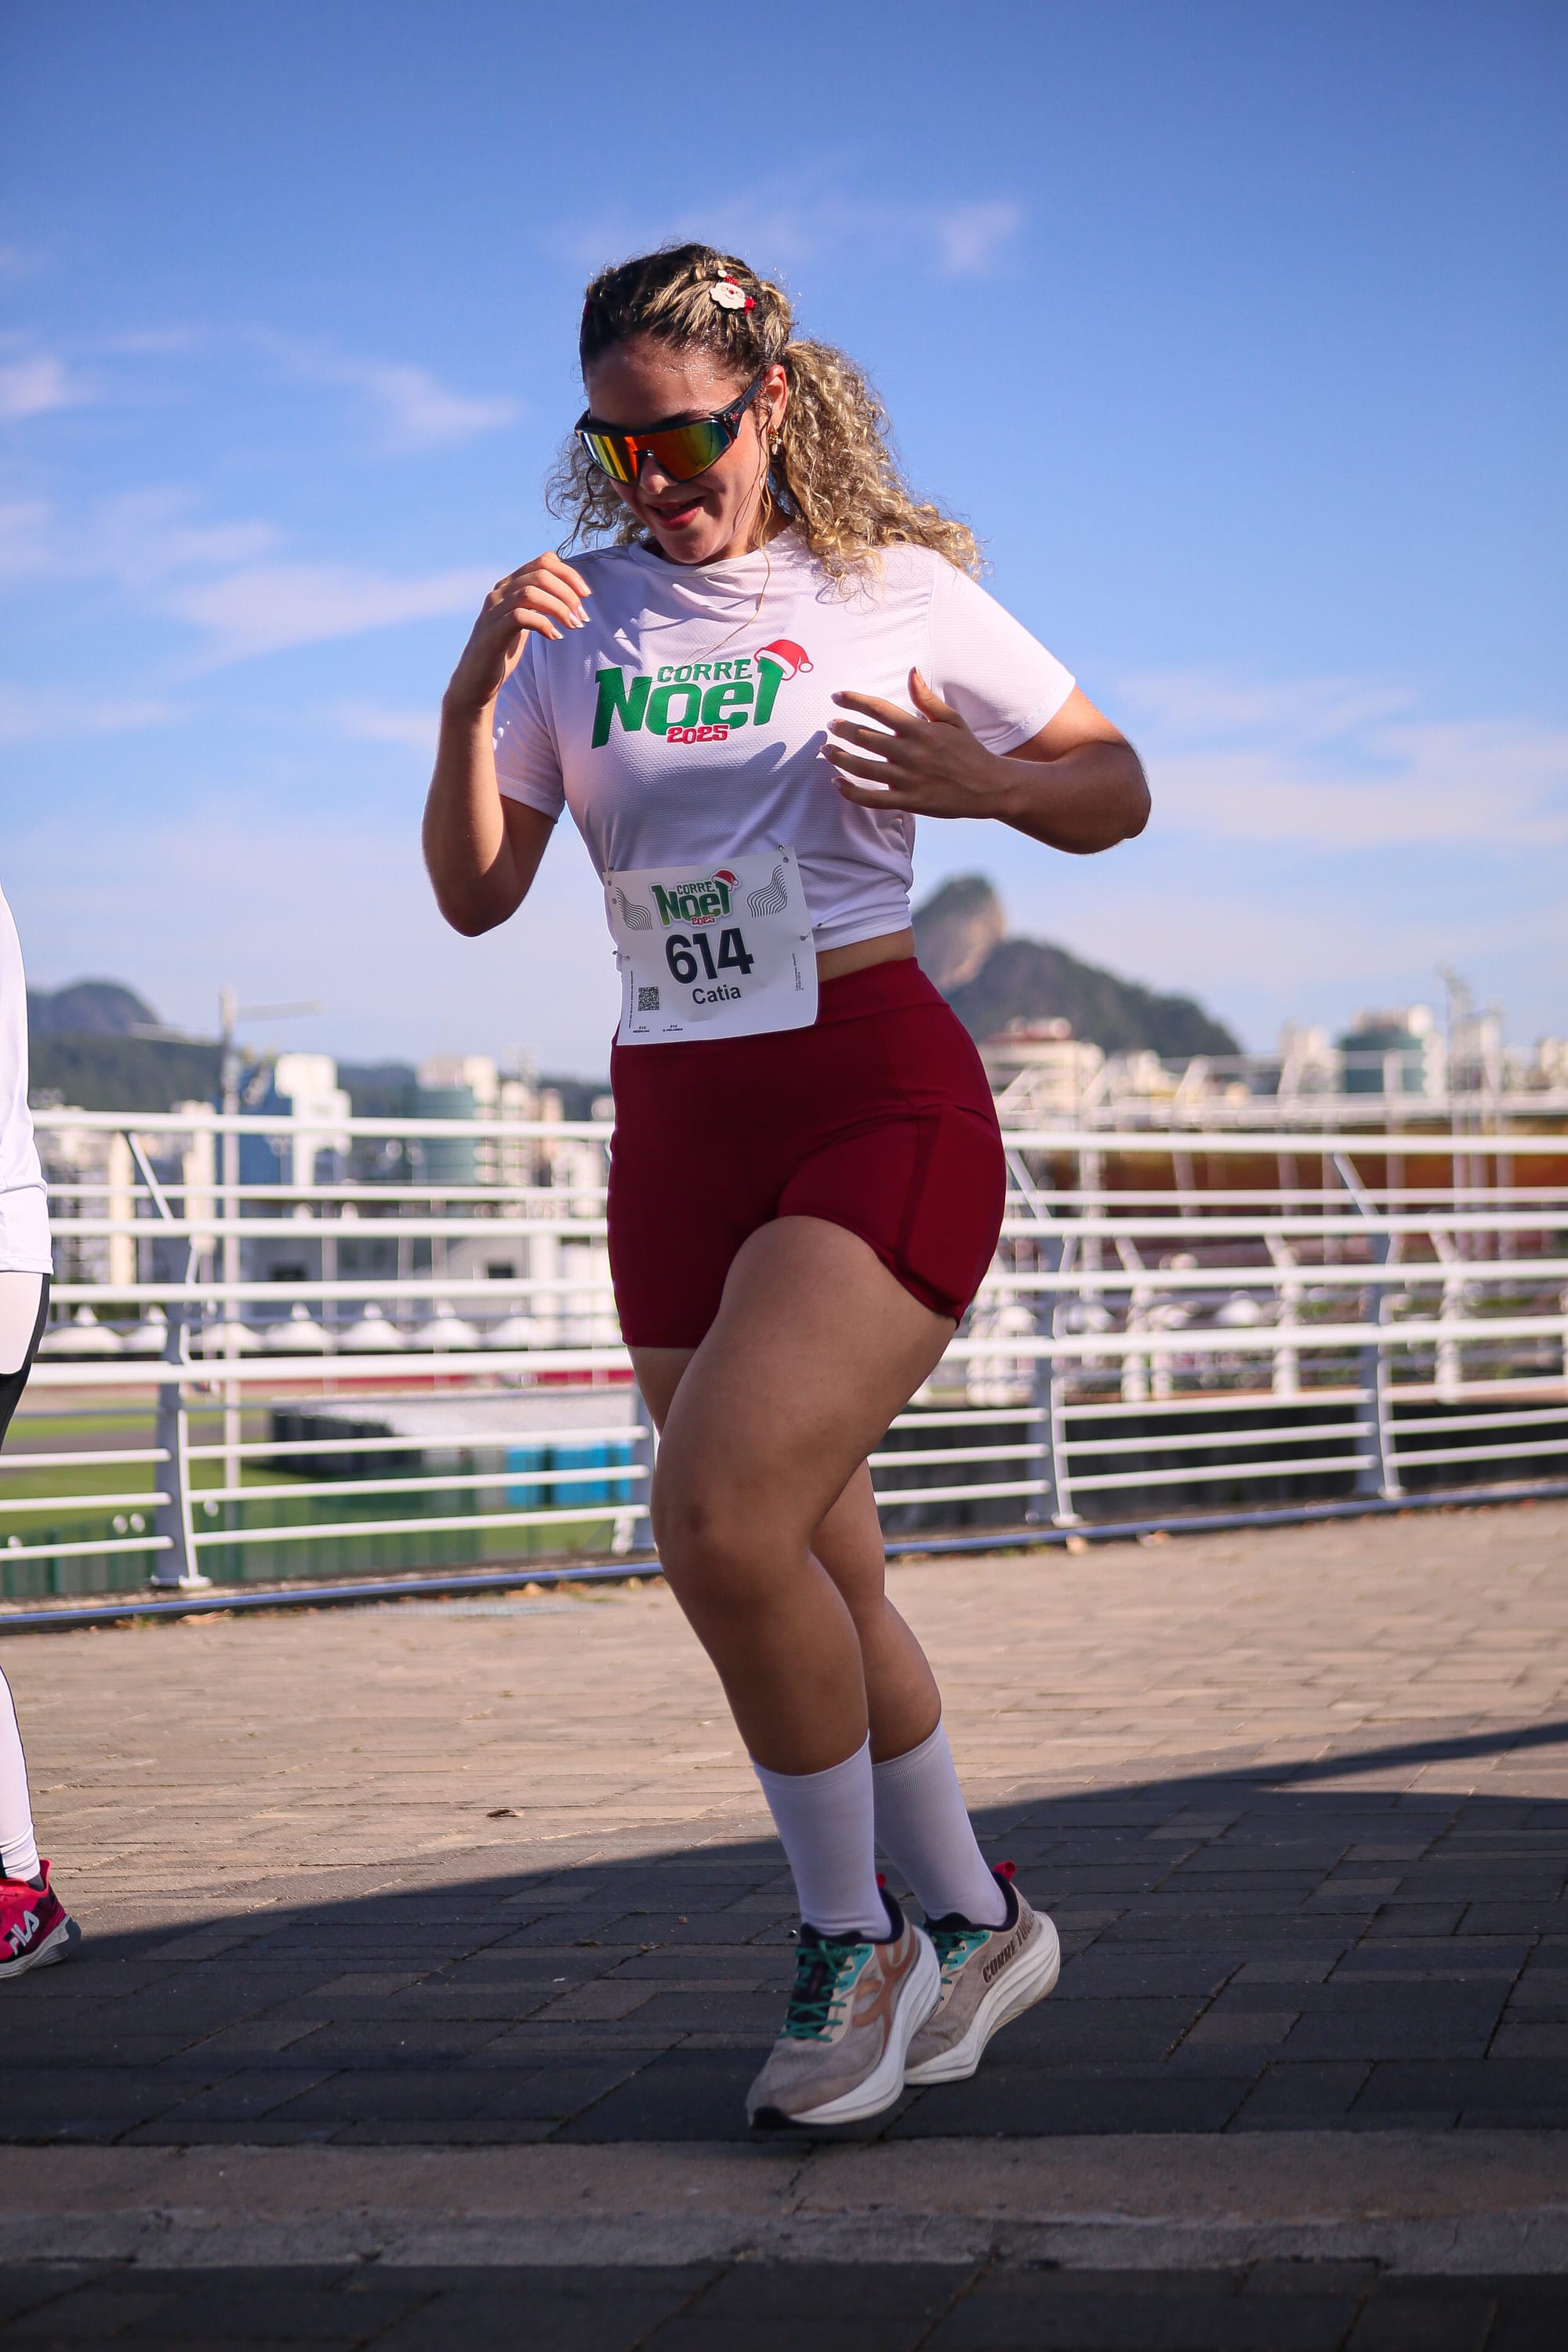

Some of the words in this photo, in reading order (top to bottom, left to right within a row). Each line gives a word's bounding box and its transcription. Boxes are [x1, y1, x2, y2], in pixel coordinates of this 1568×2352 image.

[657, 659, 753, 683] CORRE
[591, 656, 785, 750] Noel
[666, 724, 729, 744] 2025
[677, 880, 716, 895] CORRE
[651, 880, 731, 926] Noel
[691, 915, 716, 925] 2025
[666, 927, 754, 984] 614
[692, 984, 742, 1004] Catia
[9, 1910, 39, 1955] FILA
